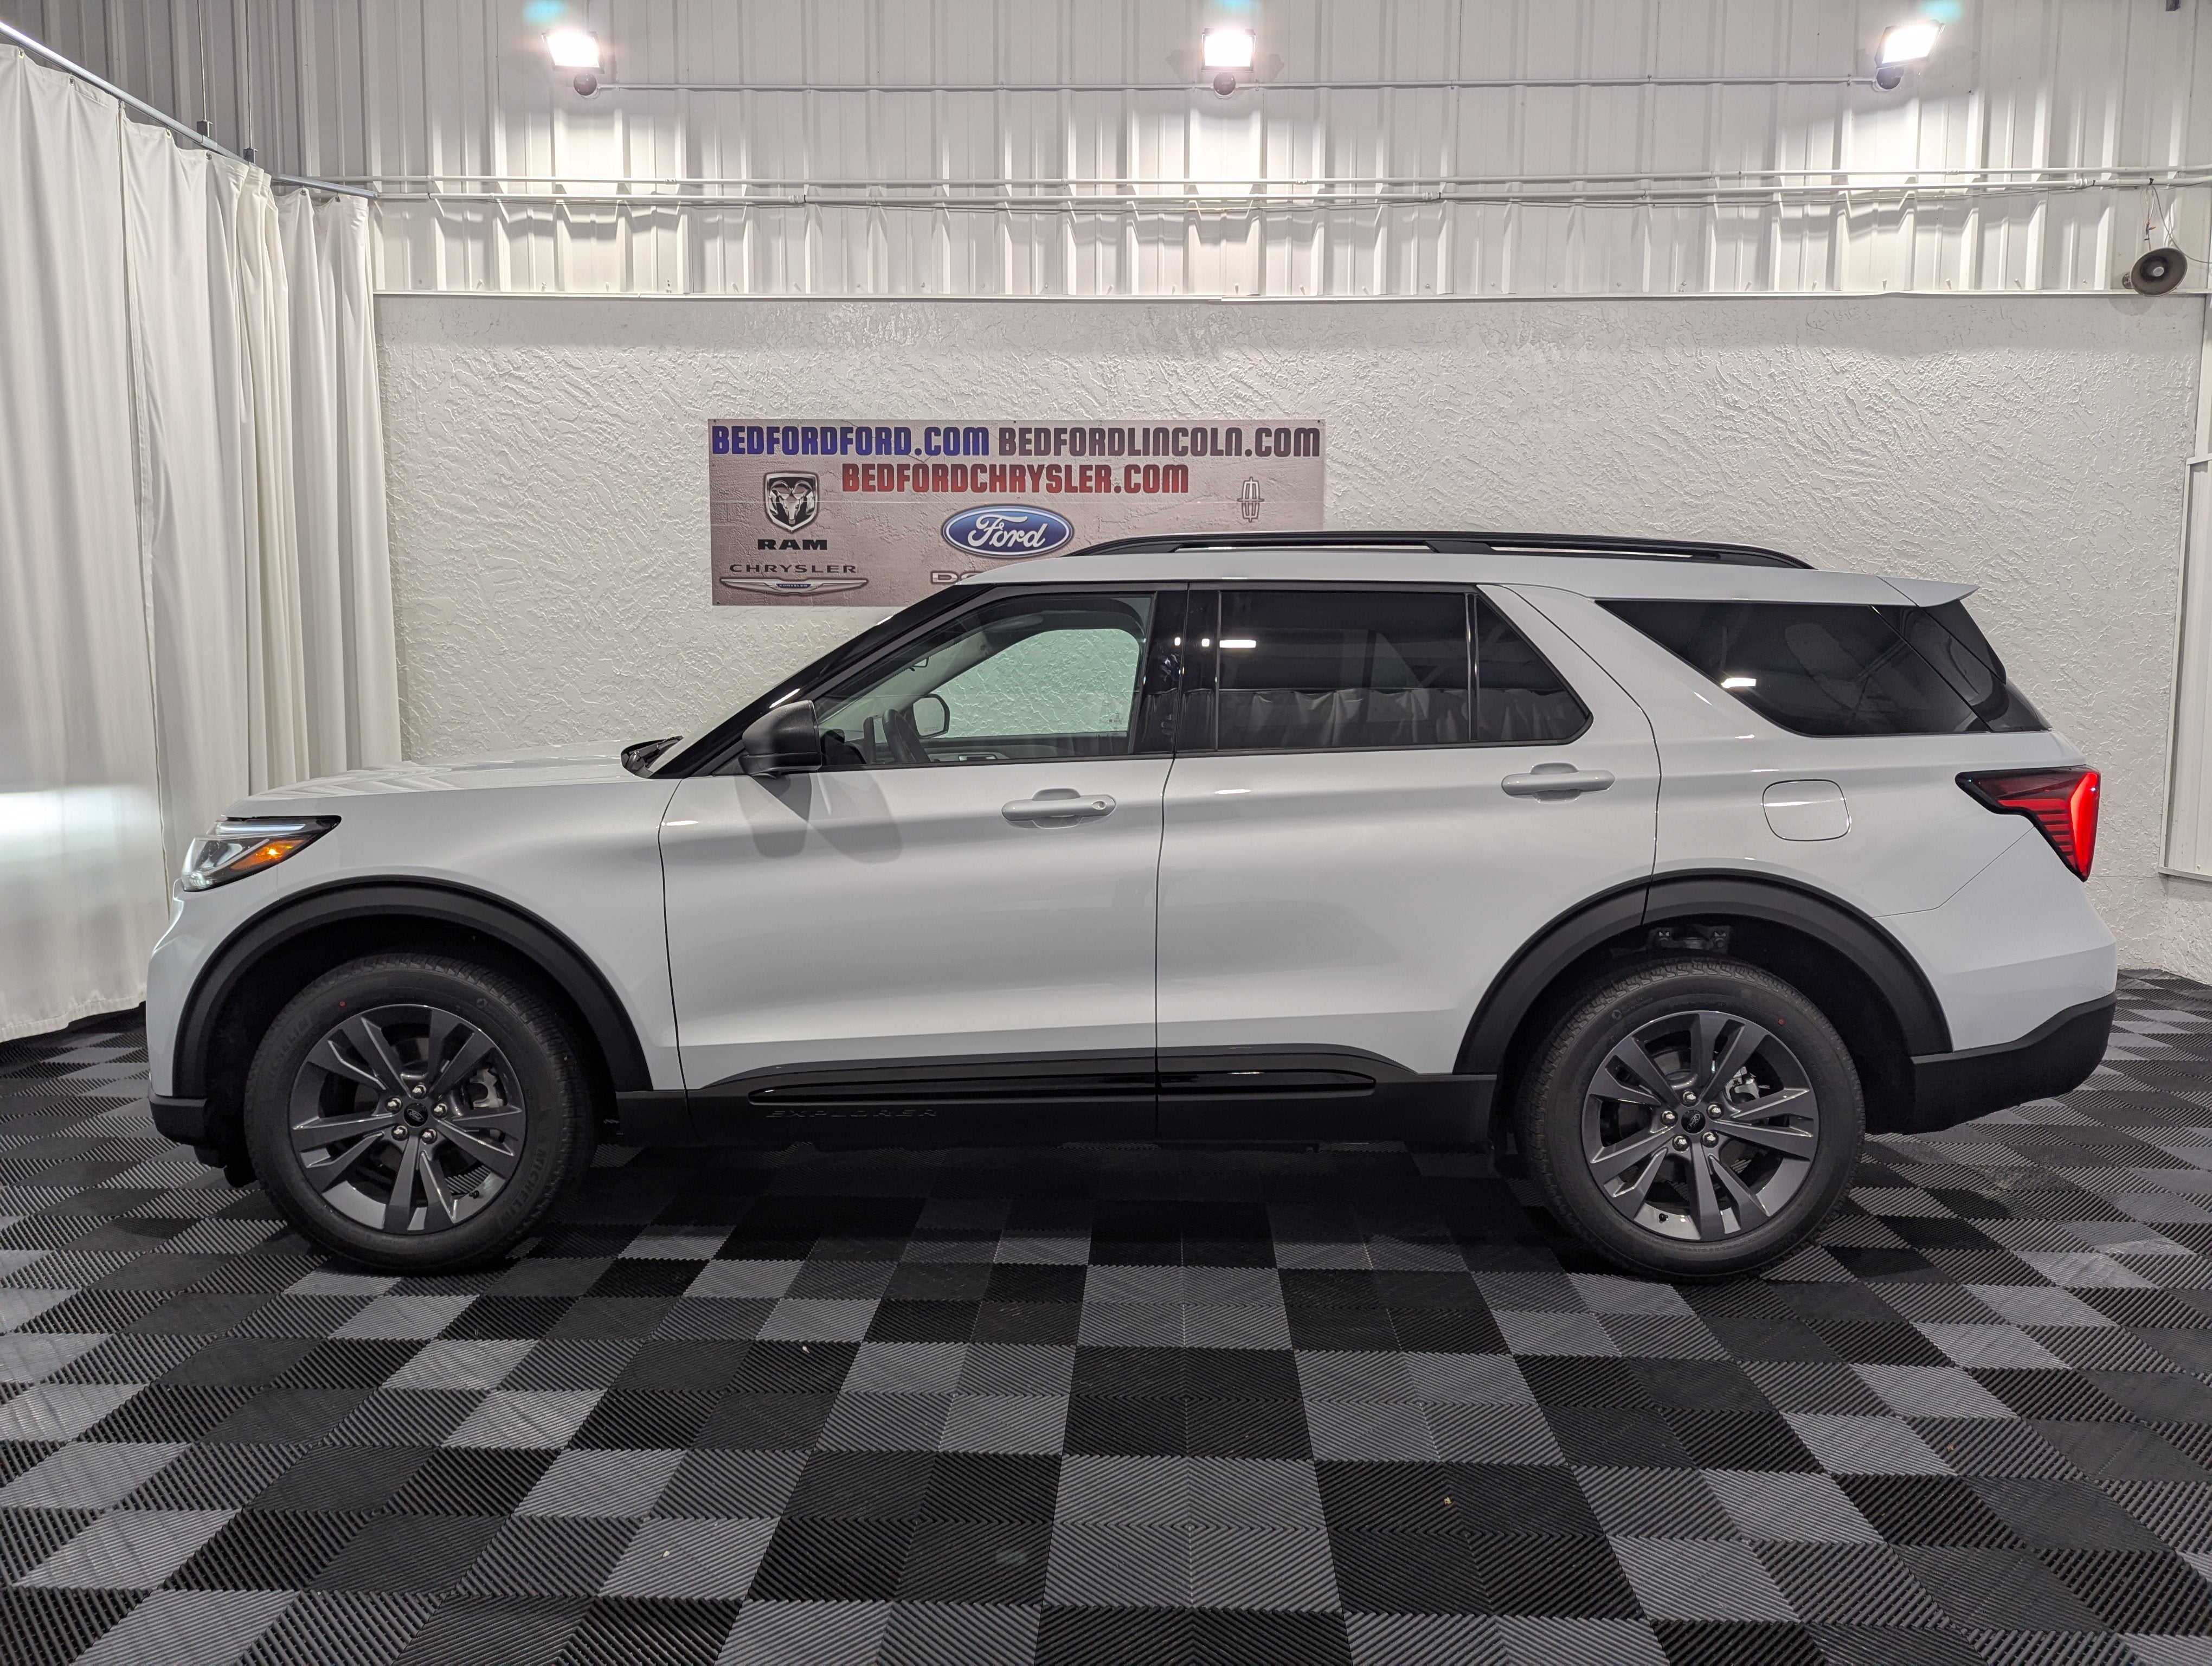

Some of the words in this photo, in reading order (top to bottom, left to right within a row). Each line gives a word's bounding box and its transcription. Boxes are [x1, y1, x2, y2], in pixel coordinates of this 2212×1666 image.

[712, 425, 989, 456] BEDFORDFORD.COM
[999, 427, 1320, 457] BEDFORDLINCOLN.COM
[842, 463, 1189, 494] BEDFORDCHRYSLER.COM
[757, 539, 828, 550] RAM
[967, 514, 1048, 548] Ford
[729, 564, 857, 573] CHRYSLER
